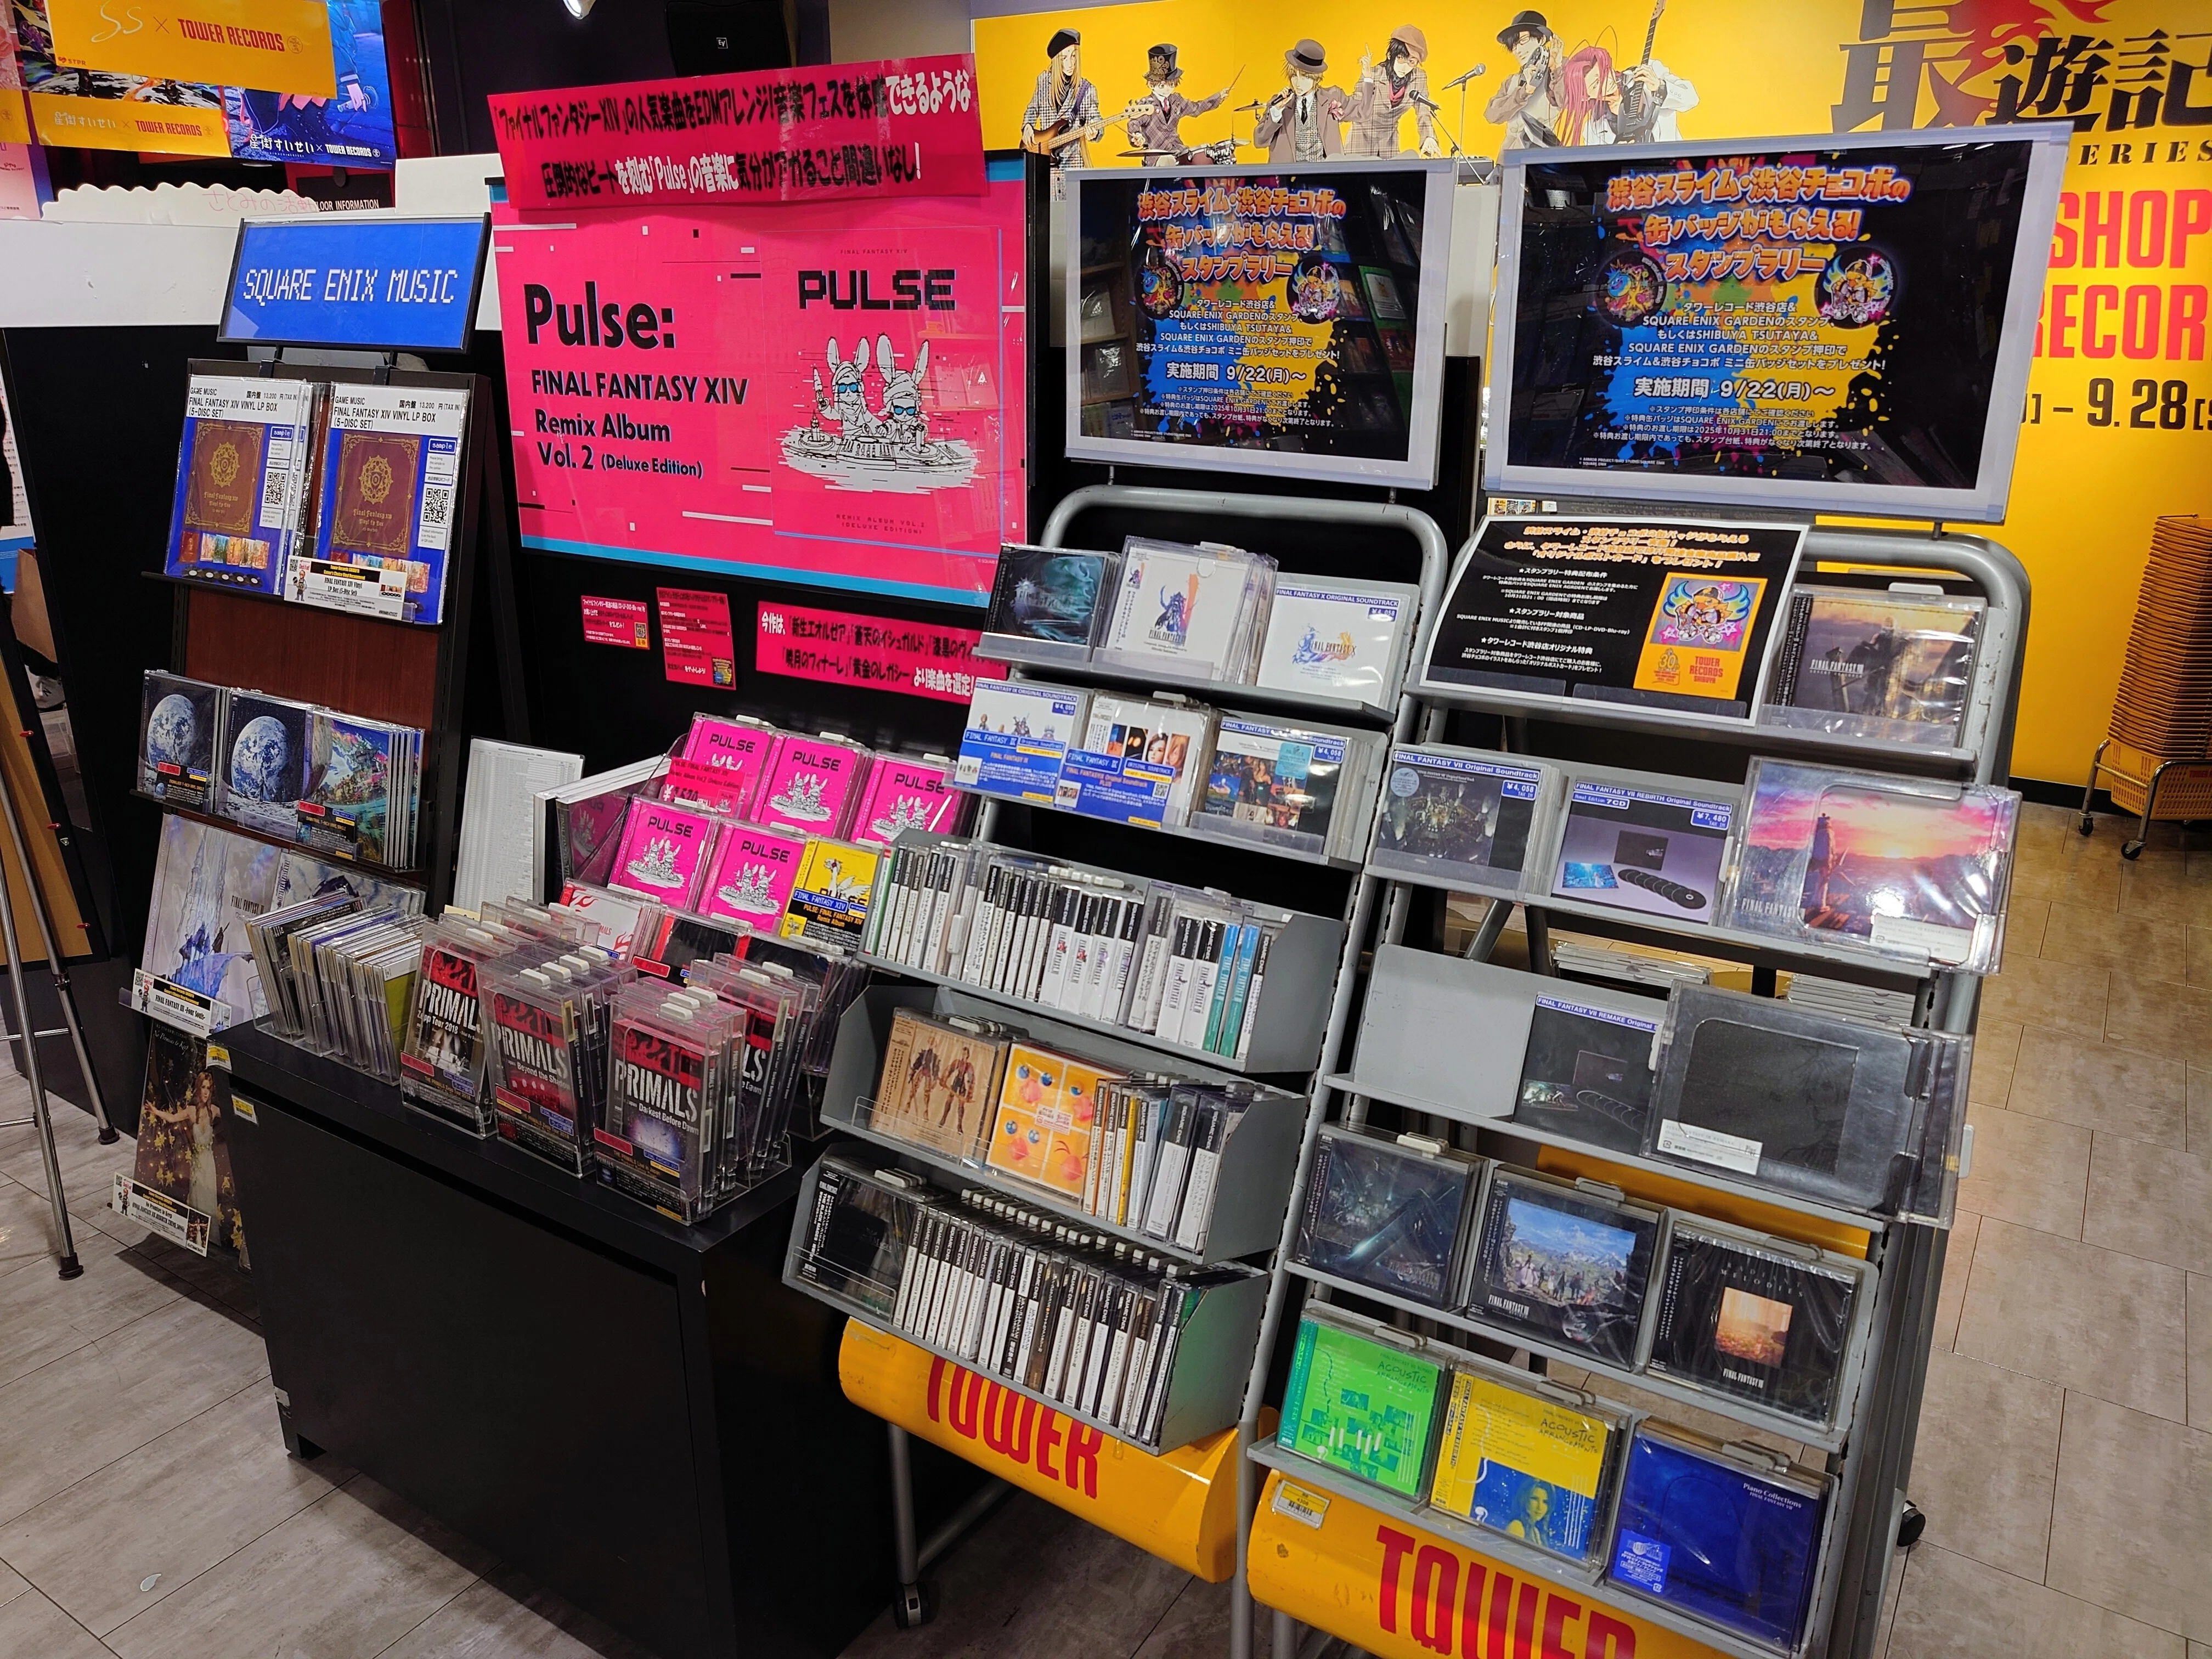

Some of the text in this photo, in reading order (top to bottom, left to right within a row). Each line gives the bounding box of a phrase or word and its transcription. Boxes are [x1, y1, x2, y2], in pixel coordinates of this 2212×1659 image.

[178, 18, 224, 44] TOWER
[227, 25, 285, 53] RECORDS
[55, 111, 203, 137] 星街すいせい TOWER RECORDS
[250, 133, 373, 157] 星街すいせい TOWER RECORDS
[2066, 139, 2212, 166] ERIES
[1606, 166, 1913, 210] 渋谷スライム・渋谷チョコボの
[317, 199, 379, 211] LOOR INFORMATION
[1643, 207, 1864, 245] 缶バッジがもらえる!
[1181, 253, 1294, 282] スタンプラリー
[1664, 244, 1830, 282] スタンプラリー
[243, 268, 459, 307] SQUARE ENIX MUSIC
[798, 269, 956, 311] PULSE
[523, 280, 676, 350] Pulse:
[1169, 309, 1224, 320] SQUARE ENIX
[1195, 298, 1276, 311] タワーレコード渋谷店&
[1683, 301, 1797, 314] タワーレコード渋谷店&
[1180, 321, 1292, 334] もしくはSHIBUYA TSUTAYA&
[1642, 314, 1720, 327] SQUARE ENIX
[1160, 332, 1193, 343] SQUARE
[1195, 334, 1214, 343] ENIX
[1657, 328, 1819, 341] もしくはSHIBUYA TSUTAYA&
[1628, 342, 1848, 358] SQUARE ENIX GARDENのスタンプ押印で
[1166, 362, 1219, 381] 実施期間
[1592, 355, 1721, 369] 渋谷スライム&渋谷チョコボ
[531, 369, 749, 405] FINAL FANTASY XIV
[1633, 376, 1711, 399] 実施期間
[335, 396, 365, 405] GAME MUSIC
[334, 407, 436, 423] FINAL FANTASY XIV VINYL LP BOX
[334, 417, 374, 430] (5-DISC SET)
[535, 408, 672, 442] Remix Album
[1716, 416, 1736, 426] ENIX
[432, 442, 453, 450] sample
[537, 441, 703, 479] Vol. 2 (Deluxe Edition)
[1276, 588, 1399, 607] FINAL FANTASY ORIGINAL SOUNDTRACK
[1689, 665, 1724, 678] RECORDS
[1695, 656, 1720, 668] TOWER
[1694, 675, 1717, 684] SHIBUYA
[990, 684, 1012, 692] FANTASY
[1018, 688, 1042, 697] ORIGINAL
[1042, 691, 1077, 702] SOUNDTRACK
[966, 731, 982, 741] FINAL
[983, 733, 1008, 744] FANTASY
[1222, 721, 1271, 735] FINAL FANTASY
[709, 732, 757, 754] PULSE
[792, 751, 842, 772] PULSE
[1068, 752, 1084, 763] FINAL
[1085, 755, 1109, 766] FANTASY
[1394, 753, 1538, 780] FINAL FANTASY Original Soundtrack
[894, 772, 946, 795] PULSE
[1576, 782, 1731, 812] FINAL FANTASY REBIRTH Original Soundtrack
[1606, 798, 1626, 808] 7CD
[647, 815, 695, 839] PULSE
[741, 840, 791, 864] PULSE
[794, 890, 847, 911] FINAL FANTASY XIV
[419, 979, 482, 1034] PRIMAL
[1537, 996, 1652, 1031] FINAL FANTASY REMAKE Original
[431, 1015, 459, 1035] Tour 2018
[490, 1021, 567, 1080] PRIMALS
[517, 1062, 571, 1091] Beyond the Shadow
[614, 1058, 698, 1123] PRIMALS
[638, 1102, 699, 1135] Darkest Before Dawn
[915, 1211, 923, 1235] SQUARE
[1070, 1270, 1078, 1294] SQUARE
[1378, 1361, 1427, 1384] ACOUSTIC
[927, 1354, 1104, 1500] TOWER
[1541, 1418, 1595, 1443] ACOUSTIC
[1742, 1482, 1803, 1509] Piano Collections
